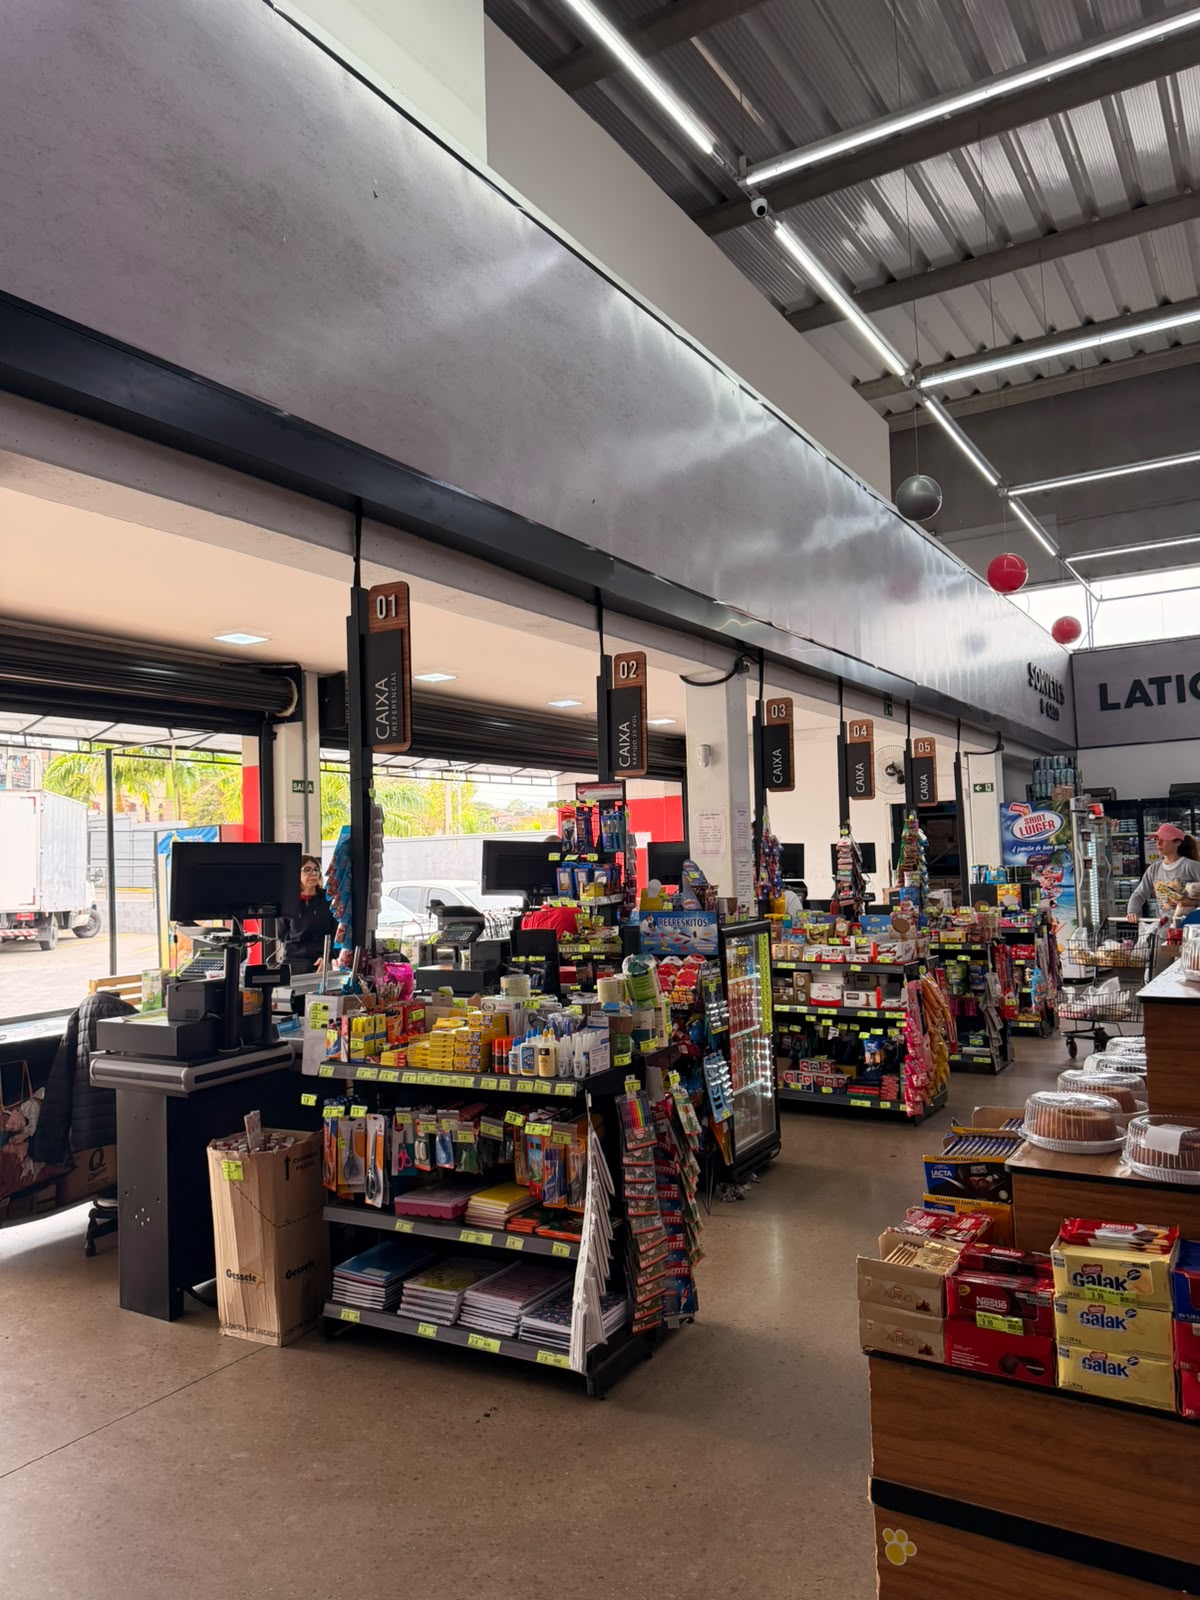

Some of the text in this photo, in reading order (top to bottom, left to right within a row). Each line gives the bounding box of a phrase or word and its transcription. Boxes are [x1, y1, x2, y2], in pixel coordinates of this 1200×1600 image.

[375, 593, 397, 619] 01
[620, 660, 637, 679] 02
[375, 677, 390, 740] CAIXA
[771, 704, 786, 719] 03
[853, 725, 868, 738] 04
[619, 721, 631, 768] CAIXA
[918, 741, 931, 753] 05
[772, 748, 783, 785] CAIXA
[855, 762, 865, 794] CAIXA
[920, 773, 929, 800] CAIXA
[1018, 819, 1056, 837] LUIGER
[1024, 813, 1046, 826] SAINT
[931, 1169, 952, 1178] LACTA
[225, 1268, 257, 1283] Gessele
[1072, 1271, 1129, 1292] Galak
[883, 1290, 912, 1302] ALPINO
[1079, 1311, 1127, 1331] Galak
[886, 1333, 915, 1346] ALPINO
[1081, 1357, 1129, 1378] Galak
